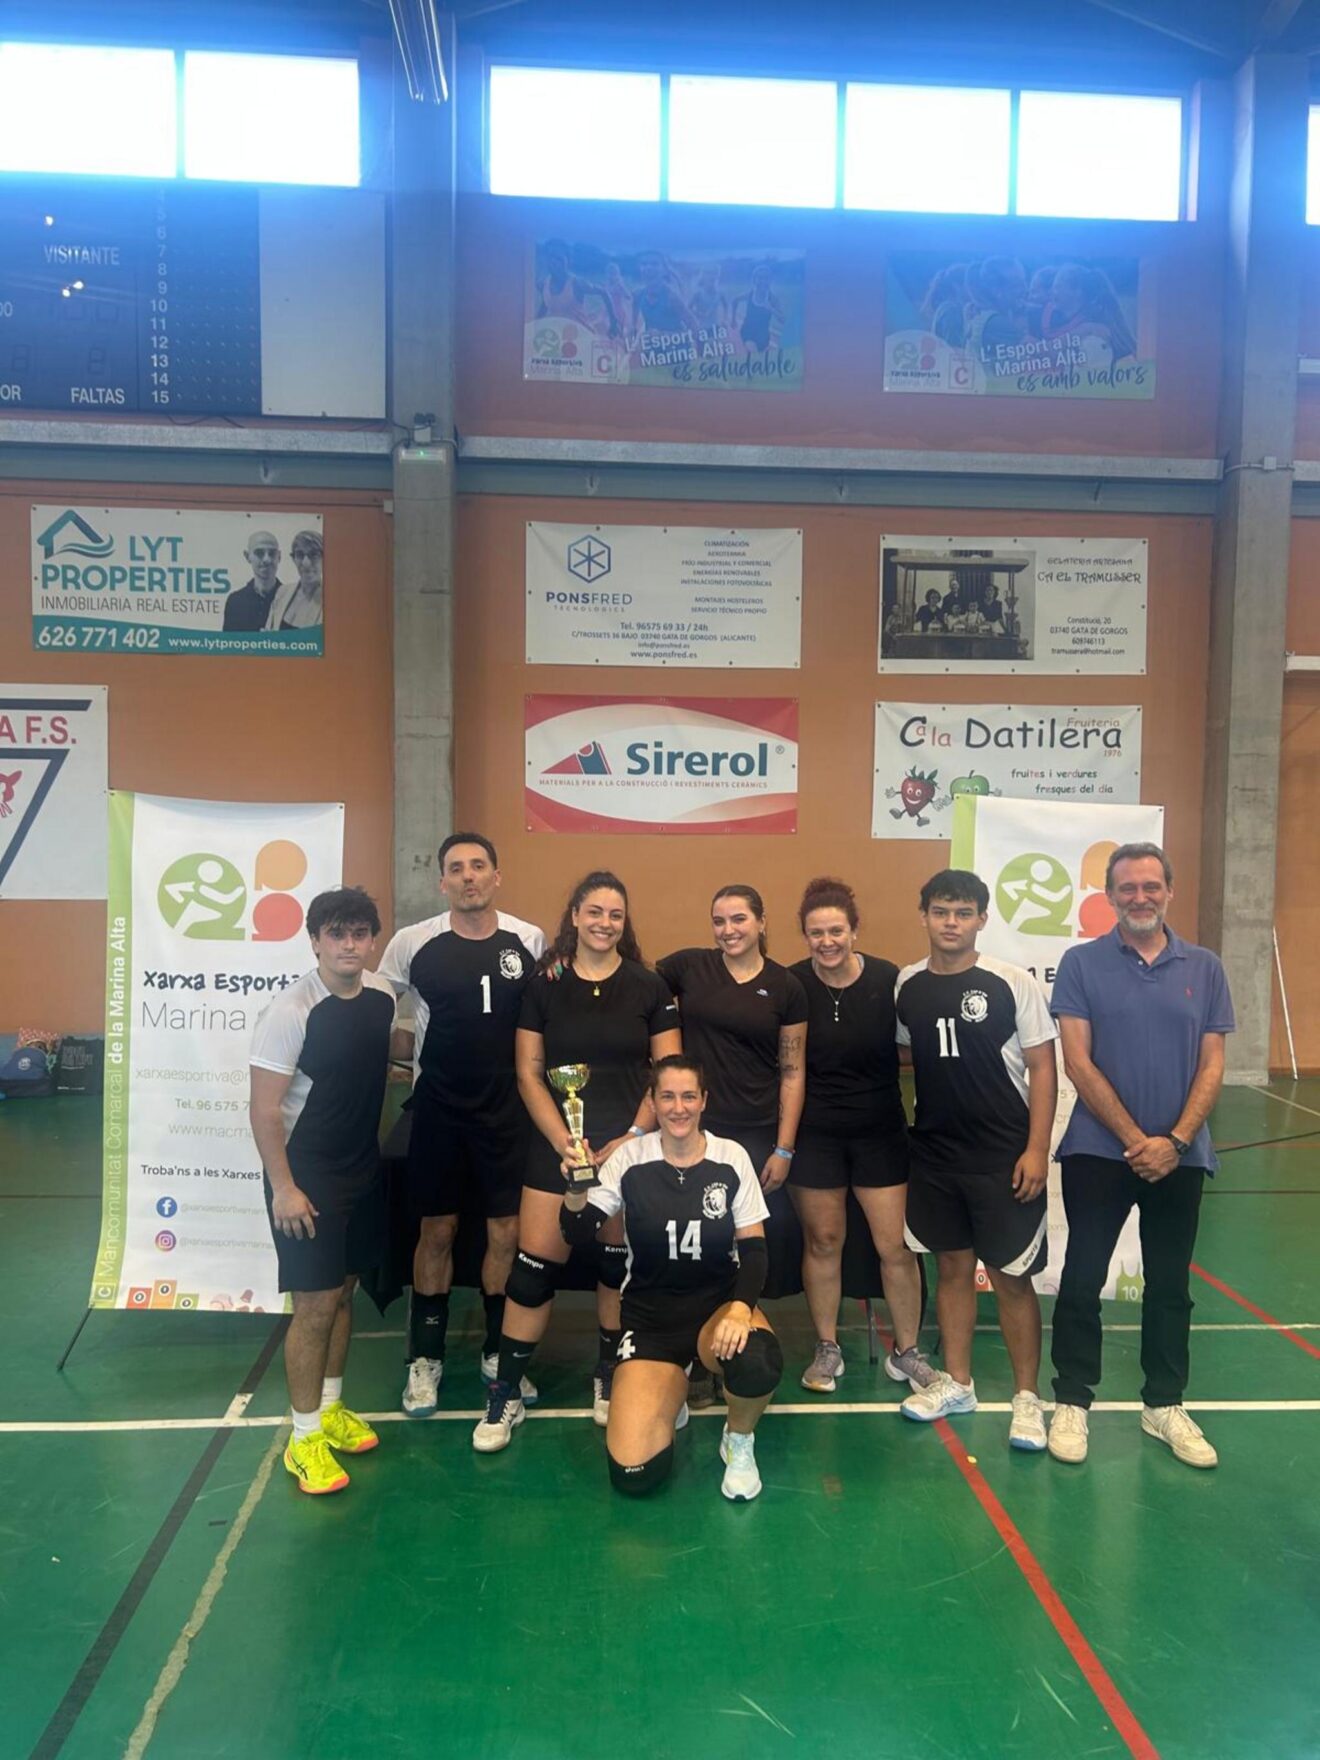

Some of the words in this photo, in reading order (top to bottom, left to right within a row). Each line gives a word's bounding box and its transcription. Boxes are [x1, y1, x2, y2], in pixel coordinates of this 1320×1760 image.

[44, 244, 120, 266] VISITANTE
[158, 244, 167, 257] 7
[158, 262, 167, 276] 8
[158, 281, 168, 295] 9
[151, 299, 168, 313] 10
[151, 317, 167, 331] 11
[151, 336, 169, 349] 12
[151, 354, 169, 368] 13
[640, 346, 698, 369] Marina
[702, 340, 736, 359] Alta
[995, 353, 1051, 377] Marina
[1056, 349, 1087, 368] Alta
[699, 348, 796, 382] saludable
[151, 372, 169, 386] 14
[1042, 360, 1080, 389] amb
[1087, 361, 1148, 388] valors
[71, 387, 125, 405] FALTAS
[152, 390, 170, 404] 15
[129, 535, 183, 562] LYT
[41, 564, 232, 594] PROPERTIES
[41, 595, 132, 612] INMOBILIARIA
[136, 598, 167, 613] REAL
[171, 599, 220, 614] ESTATE
[546, 591, 633, 605] PONSFRED
[620, 622, 633, 631] Tel.
[636, 622, 661, 632] 96575
[662, 623, 675, 632] 69
[676, 623, 686, 632] 33
[692, 623, 709, 632] 24h
[39, 626, 75, 647] 626
[81, 627, 116, 648] 771
[122, 628, 160, 648] 402
[168, 636, 318, 651] www.lytproperties.com
[689, 633, 718, 641] GORGOS
[630, 649, 699, 661] www.ponsfred.es
[25, 715, 77, 745] F.S.
[1066, 717, 1120, 728] Fruiteria
[965, 717, 1122, 750] Datilera
[626, 741, 768, 777] Sirerol
[1011, 769, 1046, 779] fruites
[1056, 769, 1098, 779] verdures
[539, 779, 581, 788] MATERIALS
[582, 780, 597, 788] PER
[604, 780, 614, 788] LA
[1035, 784, 1076, 797] fresques
[1079, 784, 1095, 794] del
[112, 916, 127, 952] Alta
[109, 956, 126, 1016] Marina
[480, 975, 492, 1014] 1
[142, 1001, 246, 1031] Marina
[108, 1020, 124, 1038] la
[936, 1017, 960, 1058] 11
[107, 1041, 124, 1064] de
[106, 1068, 123, 1151] Comarcal
[175, 1097, 194, 1110] Tel.
[196, 1099, 212, 1111] 96
[214, 1100, 239, 1112] 575
[140, 1163, 191, 1178] Troba'ns
[193, 1168, 202, 1178] a
[203, 1166, 220, 1179] les
[221, 1167, 262, 1182] Xarxes
[98, 1154, 122, 1278] Mancomunitat
[665, 1219, 702, 1261] 14
[1121, 1285, 1139, 1300] 10
